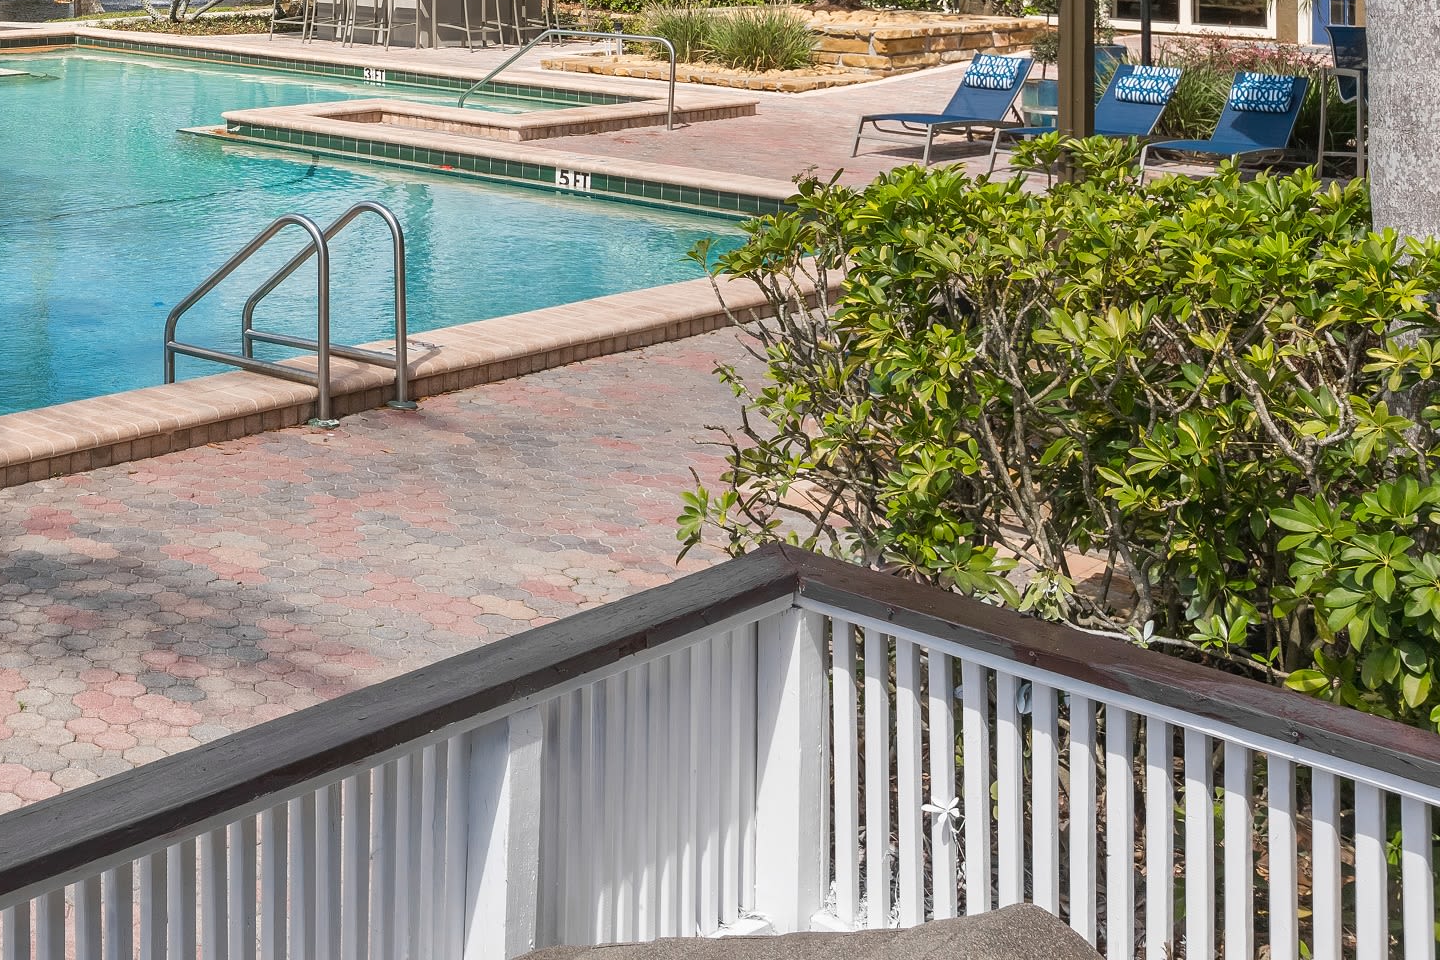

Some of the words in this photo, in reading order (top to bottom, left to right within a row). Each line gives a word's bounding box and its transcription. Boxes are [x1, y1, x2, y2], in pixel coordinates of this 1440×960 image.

[364, 67, 371, 79] 3
[375, 69, 385, 80] FT
[559, 169, 570, 186] 5
[573, 170, 590, 189] FT
